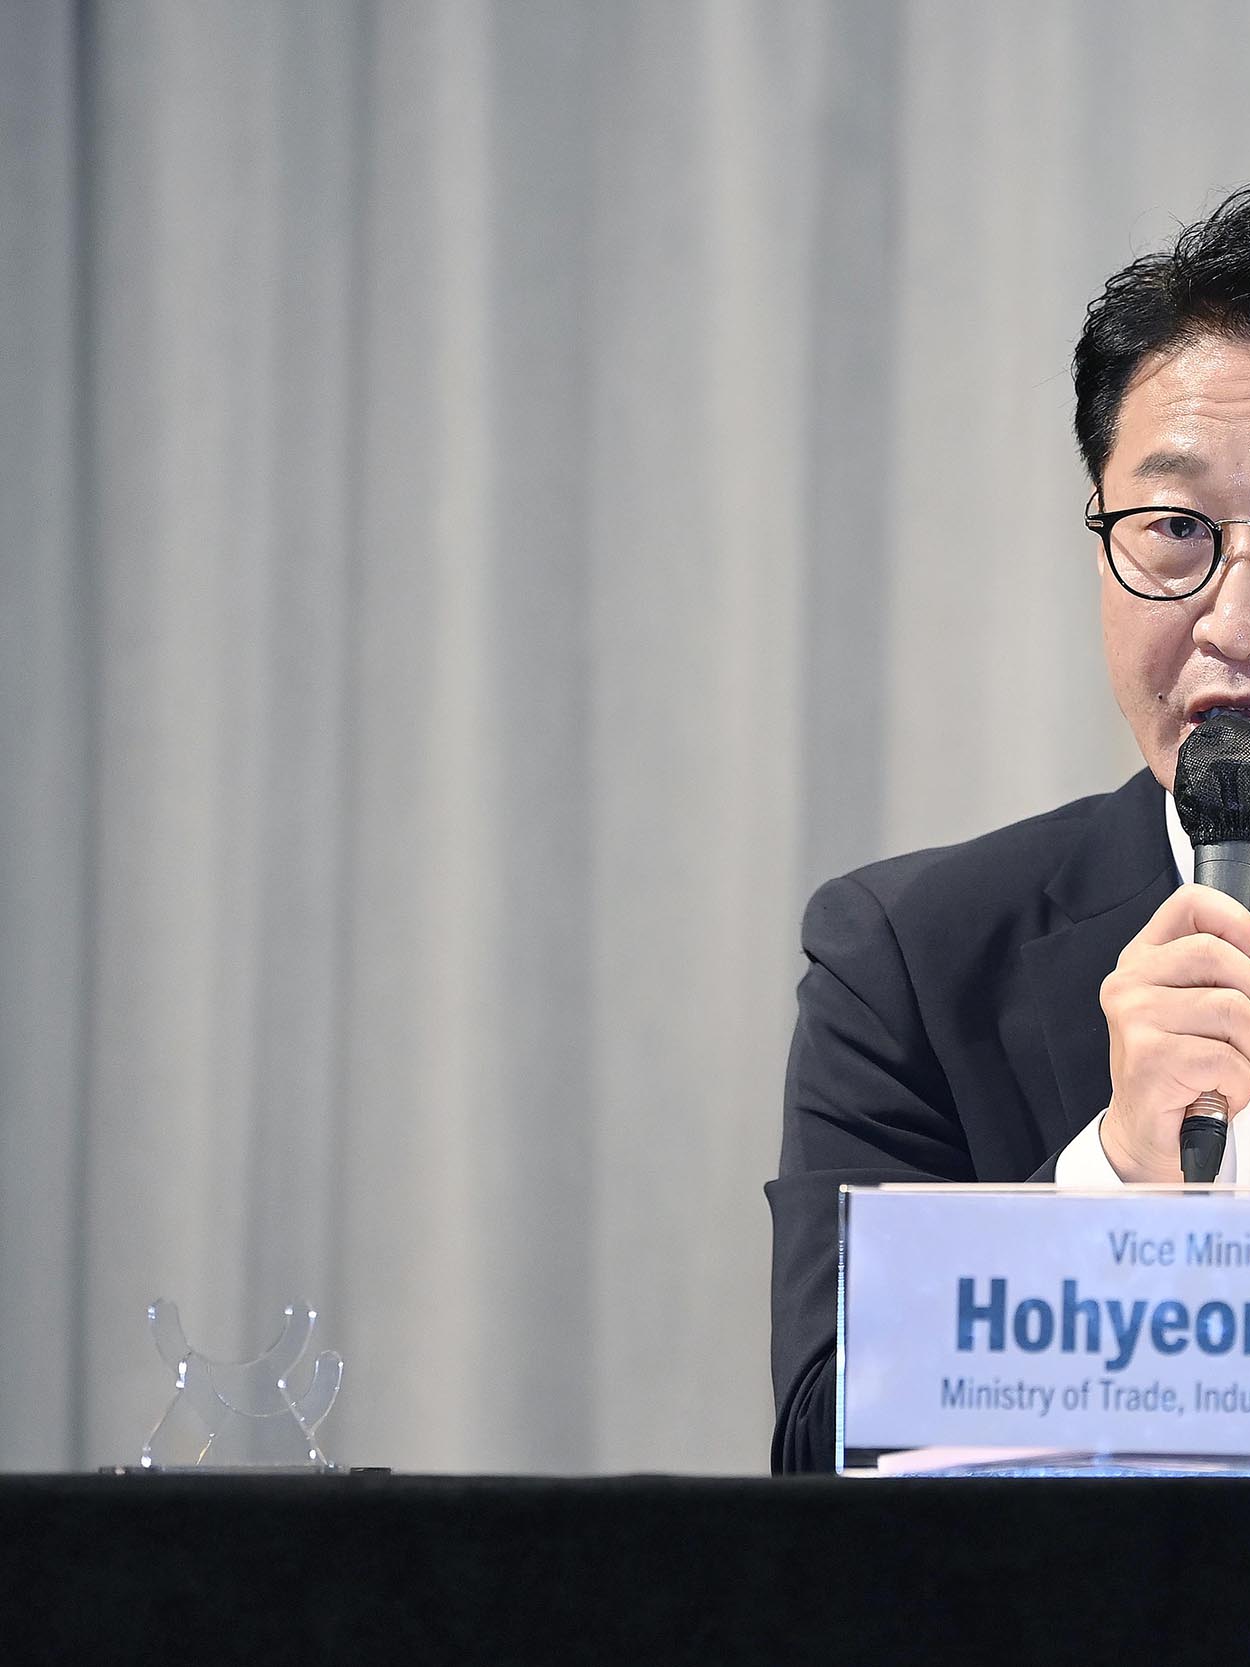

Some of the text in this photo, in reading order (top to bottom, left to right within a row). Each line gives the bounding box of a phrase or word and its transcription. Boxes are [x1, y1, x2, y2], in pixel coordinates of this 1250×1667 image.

[1108, 1231, 1175, 1266] Vice
[941, 1378, 1054, 1417] Ministry
[1063, 1381, 1090, 1412] of
[1101, 1379, 1185, 1416] Trade,
